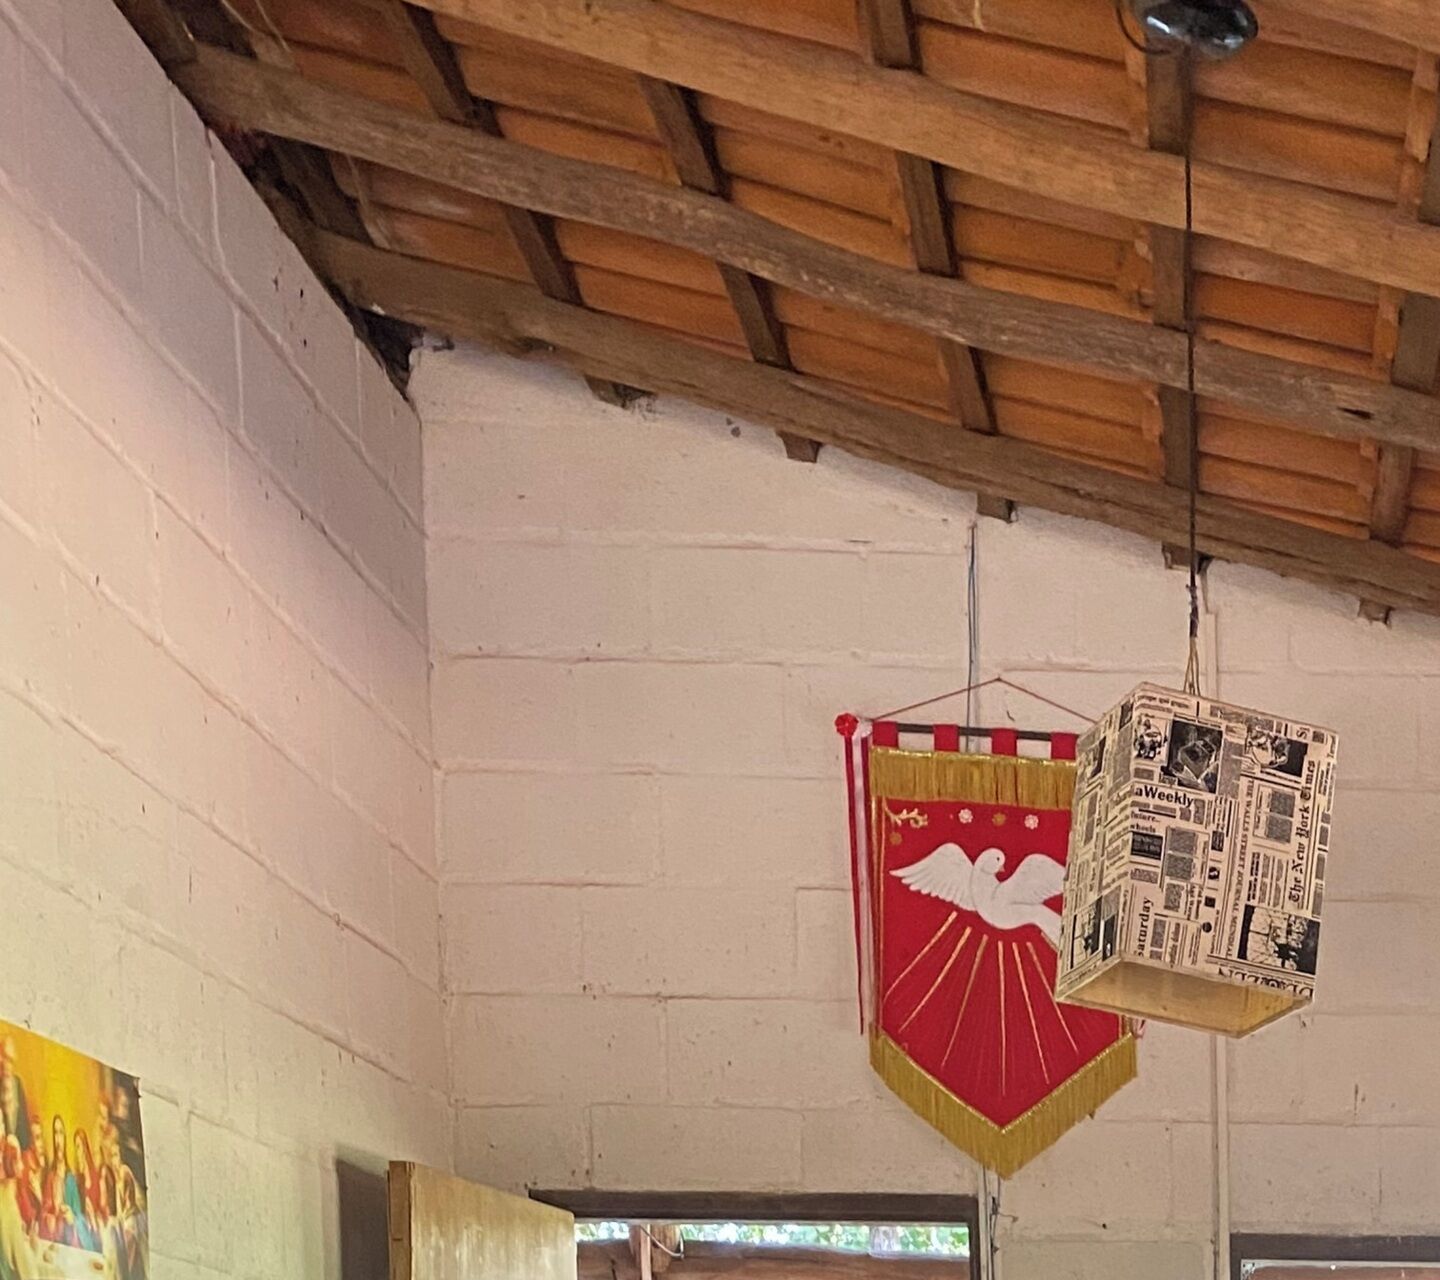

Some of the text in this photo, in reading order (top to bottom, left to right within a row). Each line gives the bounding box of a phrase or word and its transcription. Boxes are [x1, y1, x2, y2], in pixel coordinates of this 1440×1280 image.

[1288, 760, 1315, 903] The New York Times
